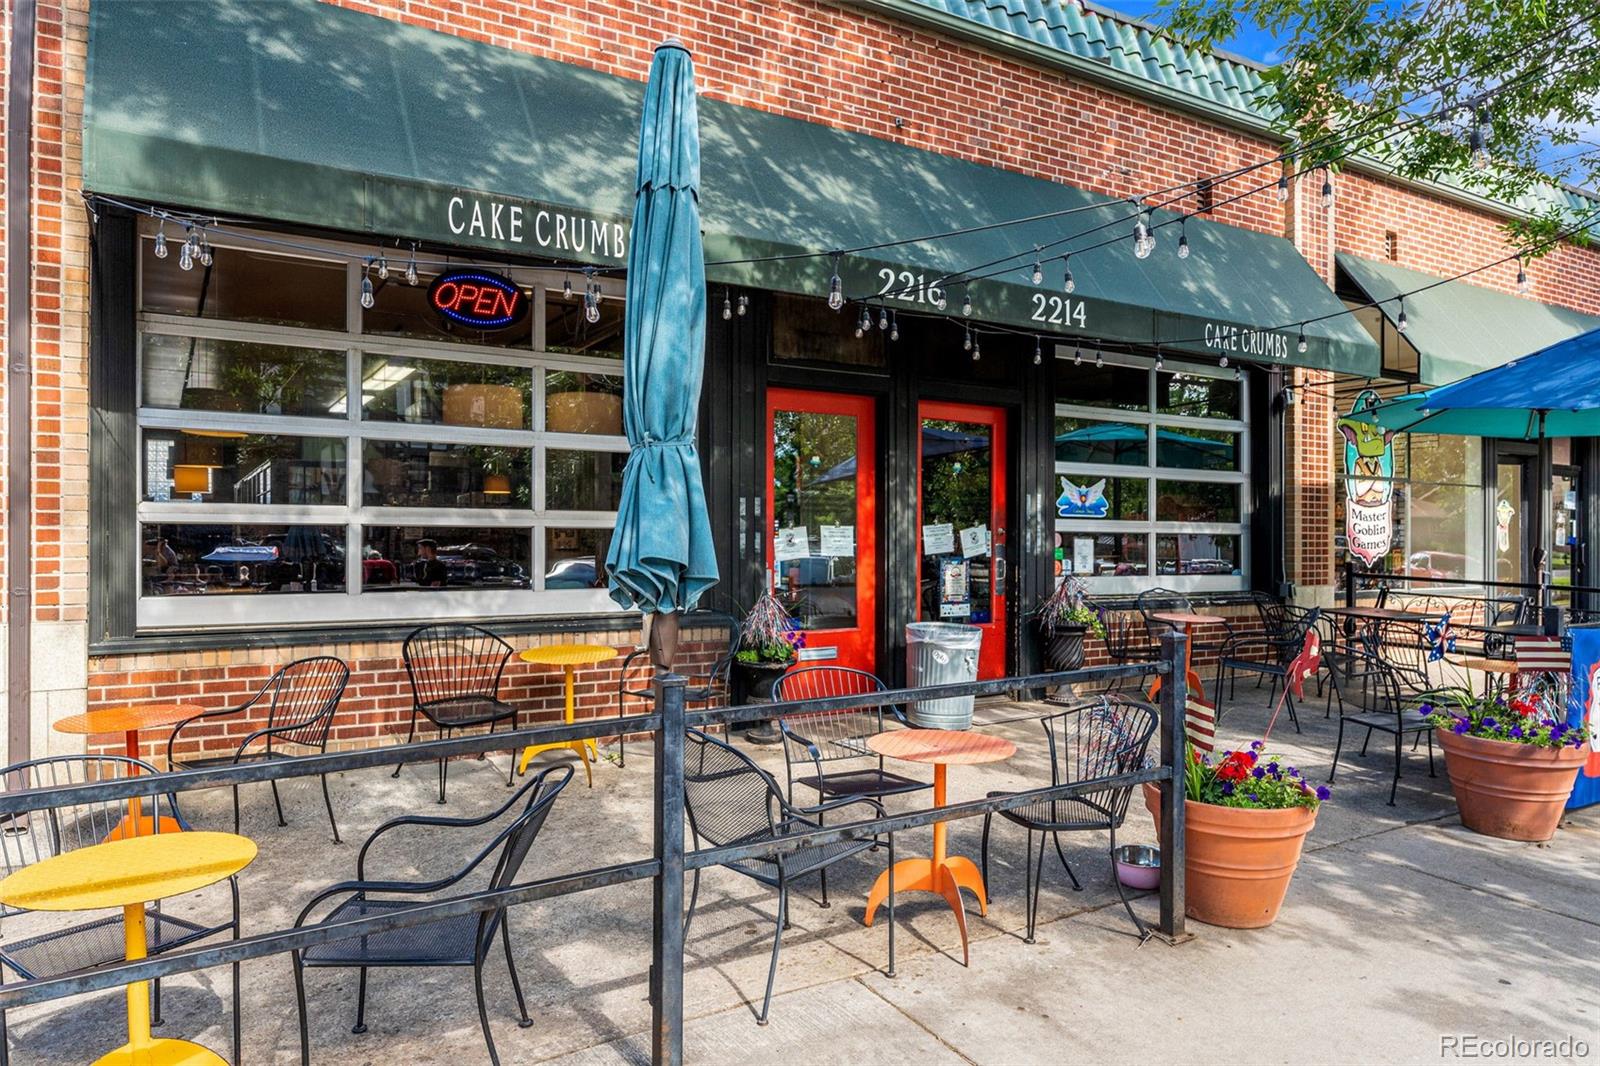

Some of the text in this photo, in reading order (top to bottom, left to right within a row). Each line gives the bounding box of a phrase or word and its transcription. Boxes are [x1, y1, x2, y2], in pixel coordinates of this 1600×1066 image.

[448, 196, 632, 258] CAKE CRUMB
[434, 282, 519, 317] OPEN
[877, 267, 947, 307] 2216
[1031, 293, 1087, 329] 2214
[1205, 323, 1288, 358] CAKE CRUMBS
[1352, 508, 1386, 521] Master
[1353, 523, 1386, 536] Goblin
[1352, 536, 1386, 549] Games
